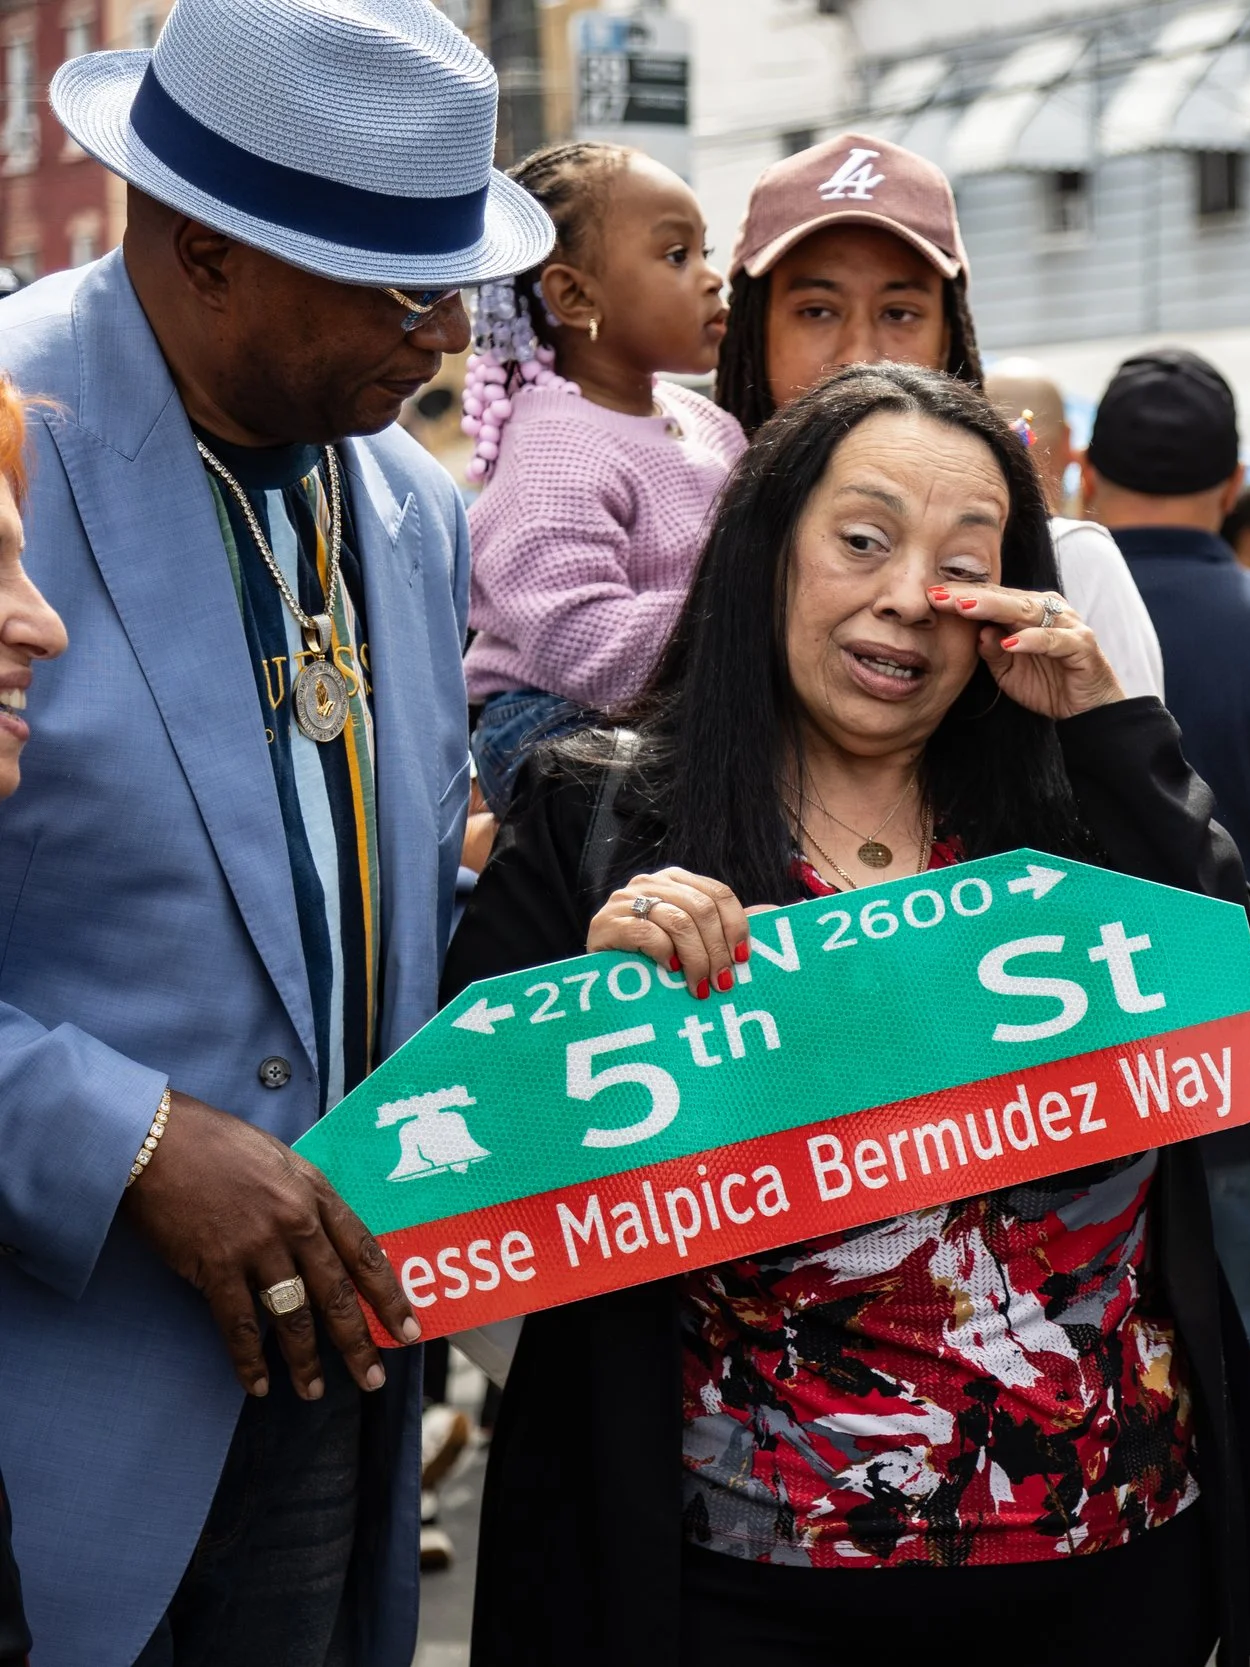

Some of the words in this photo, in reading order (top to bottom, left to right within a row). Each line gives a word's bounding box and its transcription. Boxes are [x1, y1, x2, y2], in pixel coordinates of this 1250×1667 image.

[817, 148, 885, 200] LA
[735, 917, 800, 984] N
[816, 878, 993, 952] 2600
[566, 1003, 781, 1149] 5th
[977, 921, 1167, 1042] St
[383, 1230, 537, 1308] esse
[556, 1165, 791, 1268] Malpica
[807, 1081, 1107, 1202] Bermudez
[1119, 1046, 1233, 1118] Way
